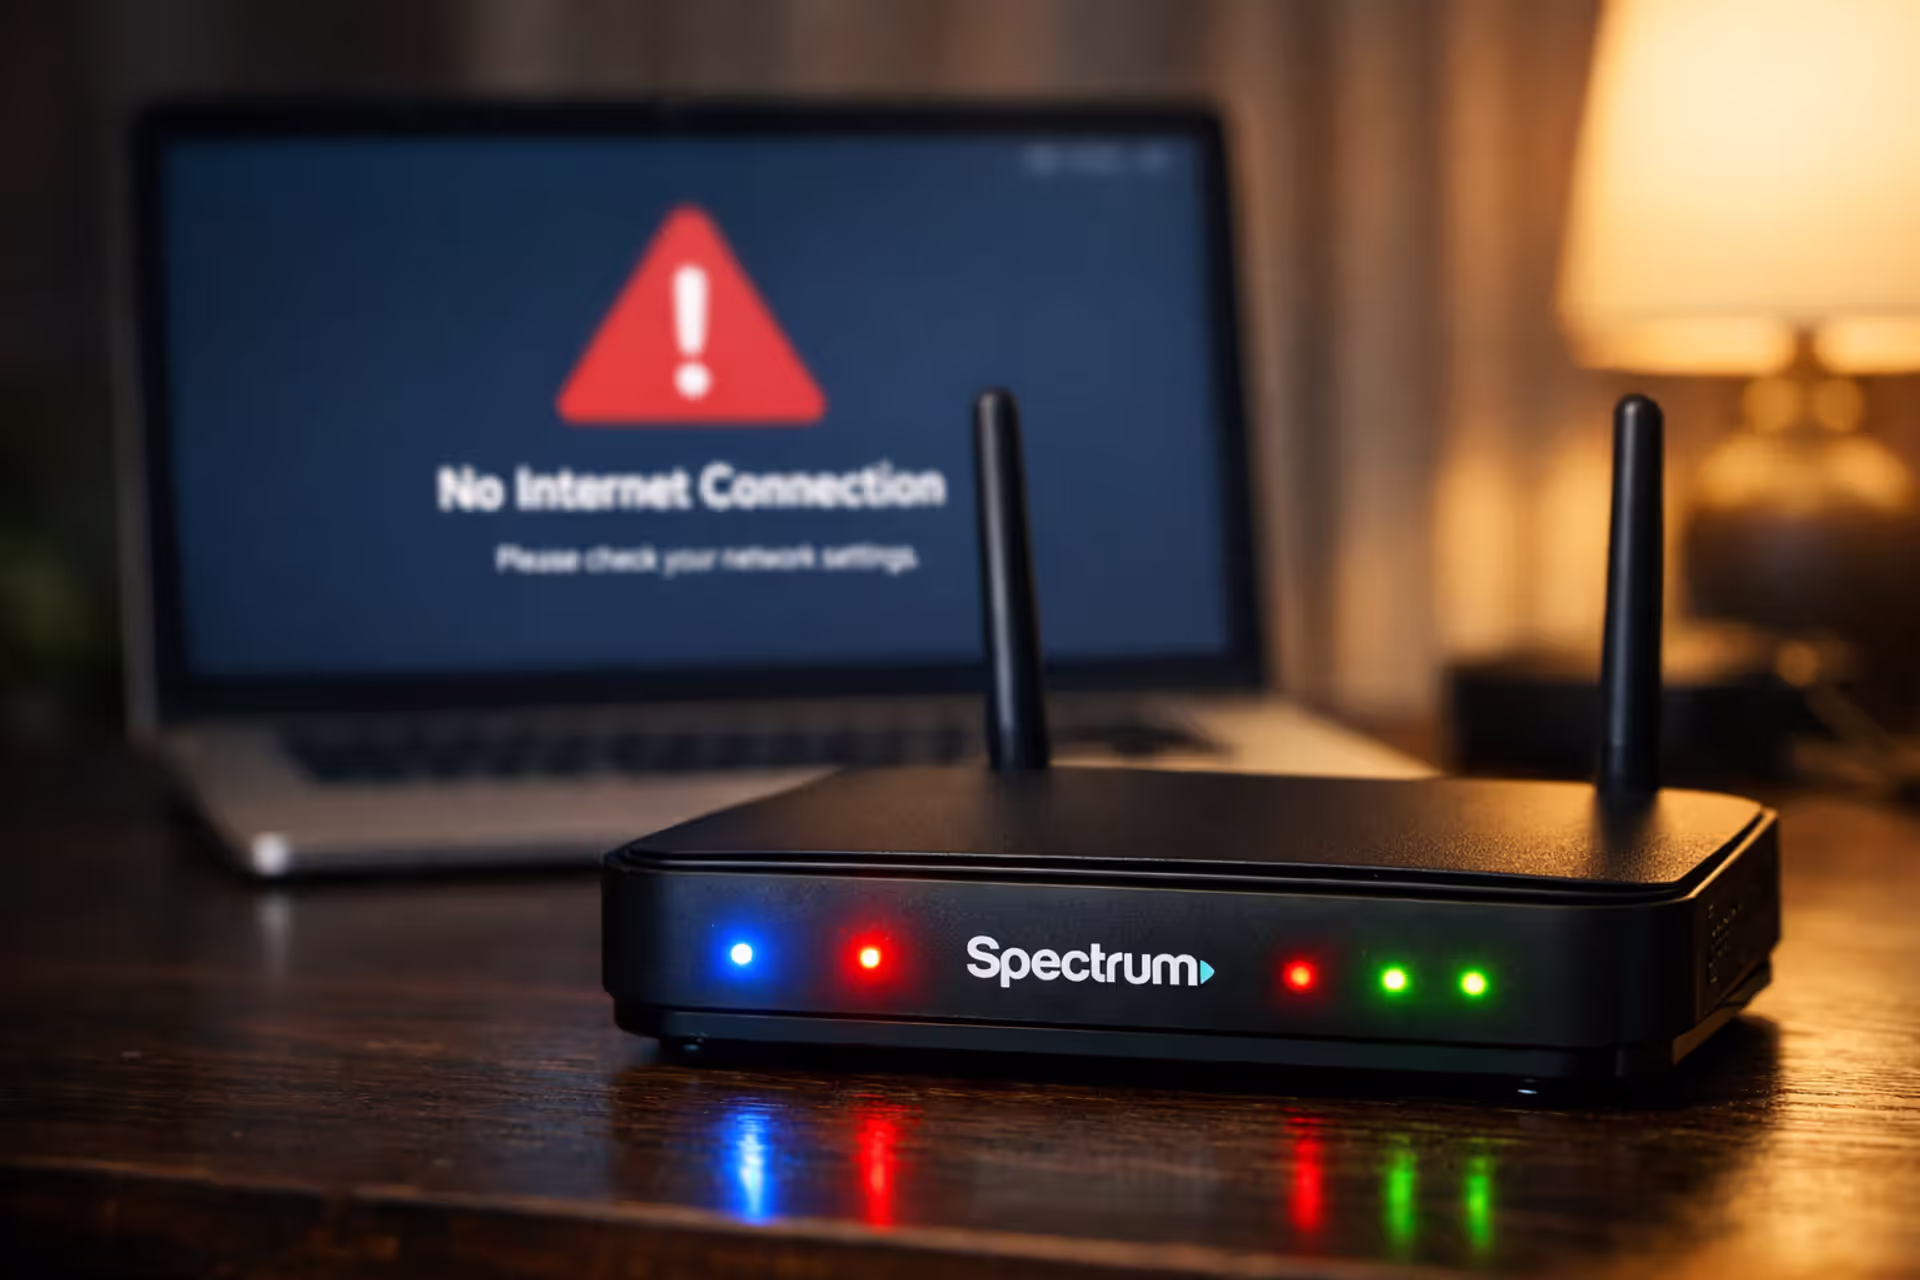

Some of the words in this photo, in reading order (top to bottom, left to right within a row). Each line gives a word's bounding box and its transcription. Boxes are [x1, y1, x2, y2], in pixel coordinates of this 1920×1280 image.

[438, 466, 504, 511] No
[515, 466, 692, 511] Internet
[698, 461, 947, 511] Connection
[495, 544, 580, 574] Please
[584, 544, 657, 574] check
[661, 547, 717, 579] your
[721, 545, 815, 573] network
[966, 935, 1199, 988] Spectrum
